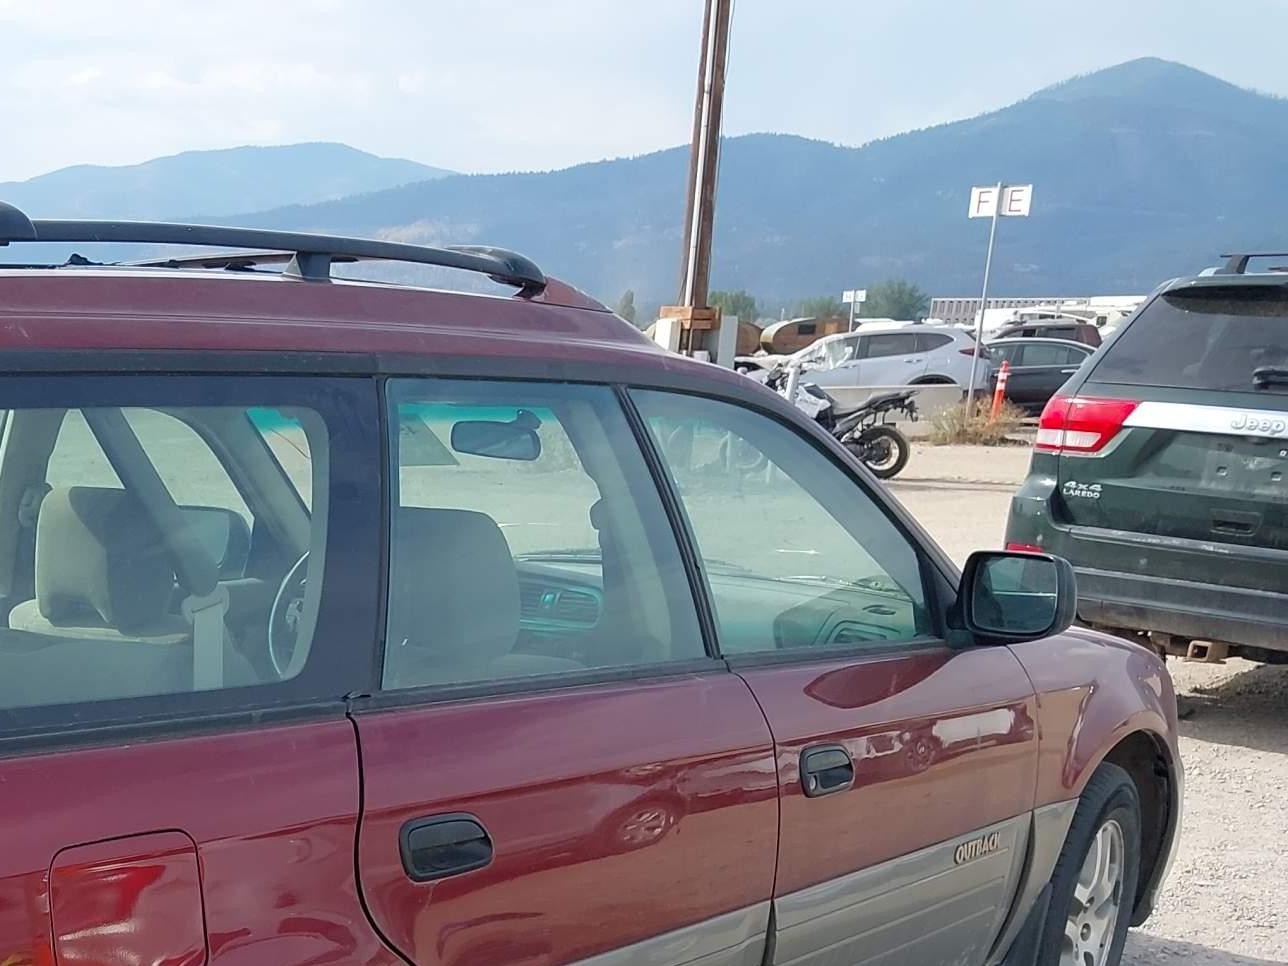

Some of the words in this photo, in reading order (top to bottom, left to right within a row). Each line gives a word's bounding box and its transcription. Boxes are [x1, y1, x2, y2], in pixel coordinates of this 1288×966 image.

[976, 190, 993, 214] F
[1008, 189, 1024, 212] E
[1230, 413, 1286, 436] Jeep
[1063, 480, 1103, 492] 4x4
[1063, 487, 1100, 499] LAREDO
[953, 831, 1001, 865] OUTBACK
